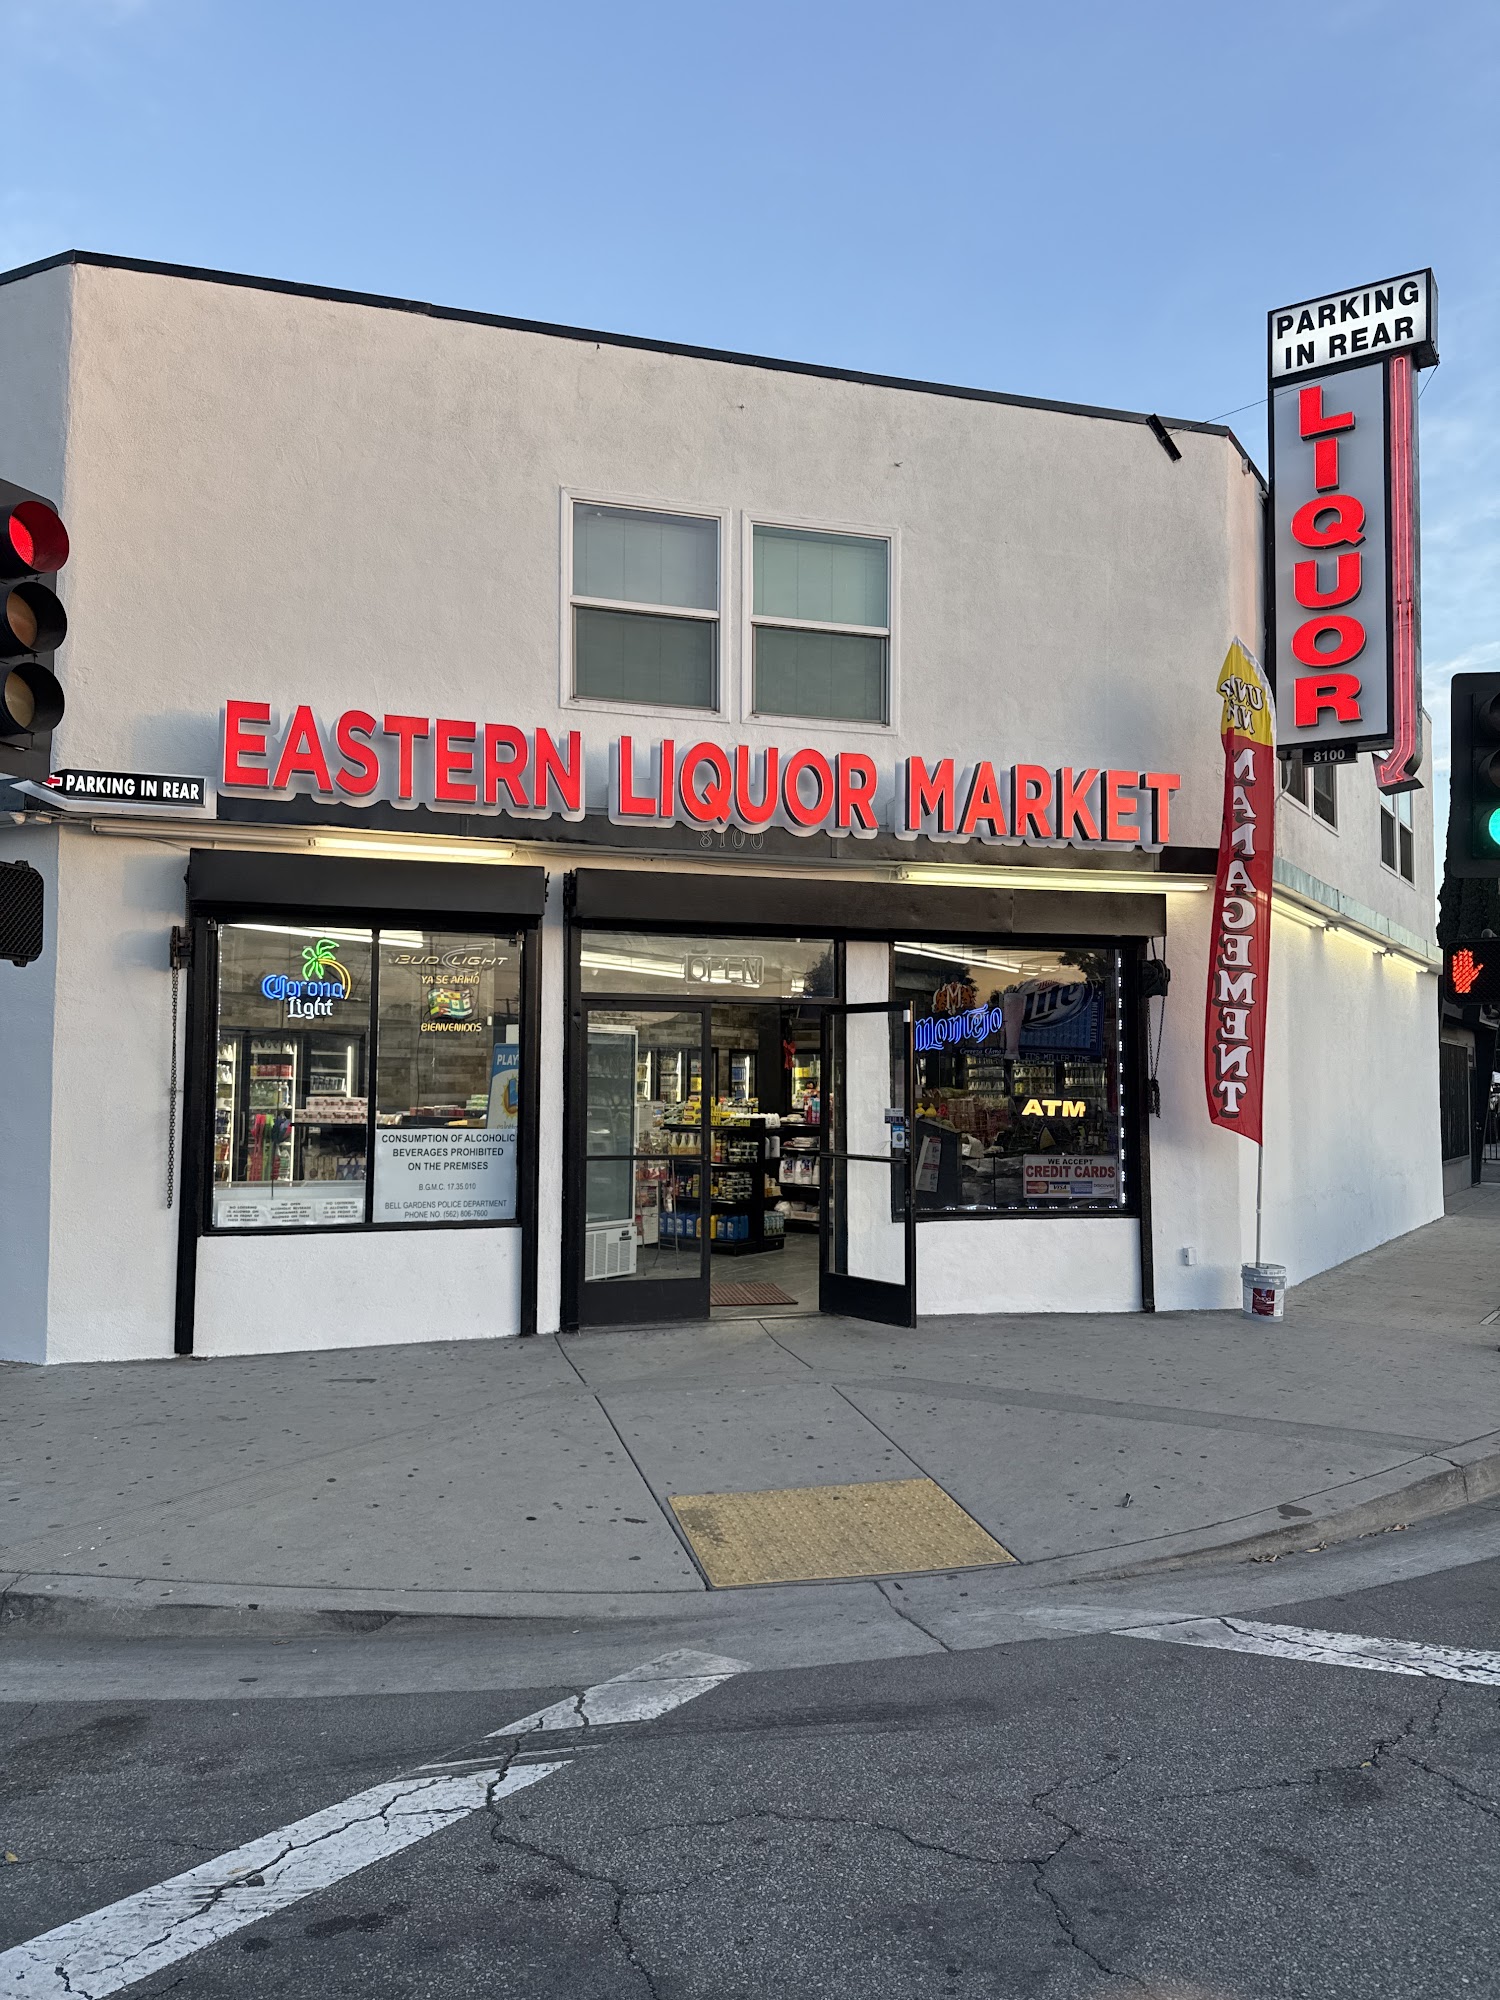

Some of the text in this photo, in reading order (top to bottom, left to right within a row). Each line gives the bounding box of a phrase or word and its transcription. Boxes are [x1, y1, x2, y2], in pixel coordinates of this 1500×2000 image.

[1276, 280, 1419, 340] PARKING
[1285, 316, 1414, 370] IN REAR
[1291, 385, 1367, 730] LIQUOR
[1313, 749, 1346, 763] 8100
[223, 699, 1182, 844] EASTERN LIQUOR MARKET
[65, 774, 200, 800] PARKING IN REAR
[699, 829, 764, 851] 8100
[393, 954, 509, 966] BUD LIGHT
[690, 957, 761, 983] OPEN
[421, 975, 434, 984] YA
[435, 974, 449, 984] SE
[261, 974, 344, 1001] Corona
[287, 996, 334, 1020] Light
[1091, 1001, 1099, 1027] MILLER
[420, 1022, 483, 1032] BIENVENIDOS
[914, 1003, 1003, 1051] Montejo
[496, 1054, 519, 1066] PLAY
[1024, 1052, 1091, 1063] IT'S MILLER TIME
[1021, 1098, 1086, 1118] ATM
[885, 1116, 904, 1124] PULL
[381, 1133, 516, 1143] CONSUMPTION OF ALCOHOLIC
[392, 1147, 504, 1157] BEVERAGES PROHIBITED
[407, 1161, 489, 1171] ON THE PREMISES
[1062, 1158, 1094, 1166] ACCEPT
[1025, 1165, 1116, 1178] CREDIT CARDS
[418, 1183, 445, 1191] B.G.M.C.
[384, 1199, 507, 1210] BELL GARDENS POLICE DEPARTMENT
[404, 1209, 489, 1219] PHONE NO. (562) 806-7600
